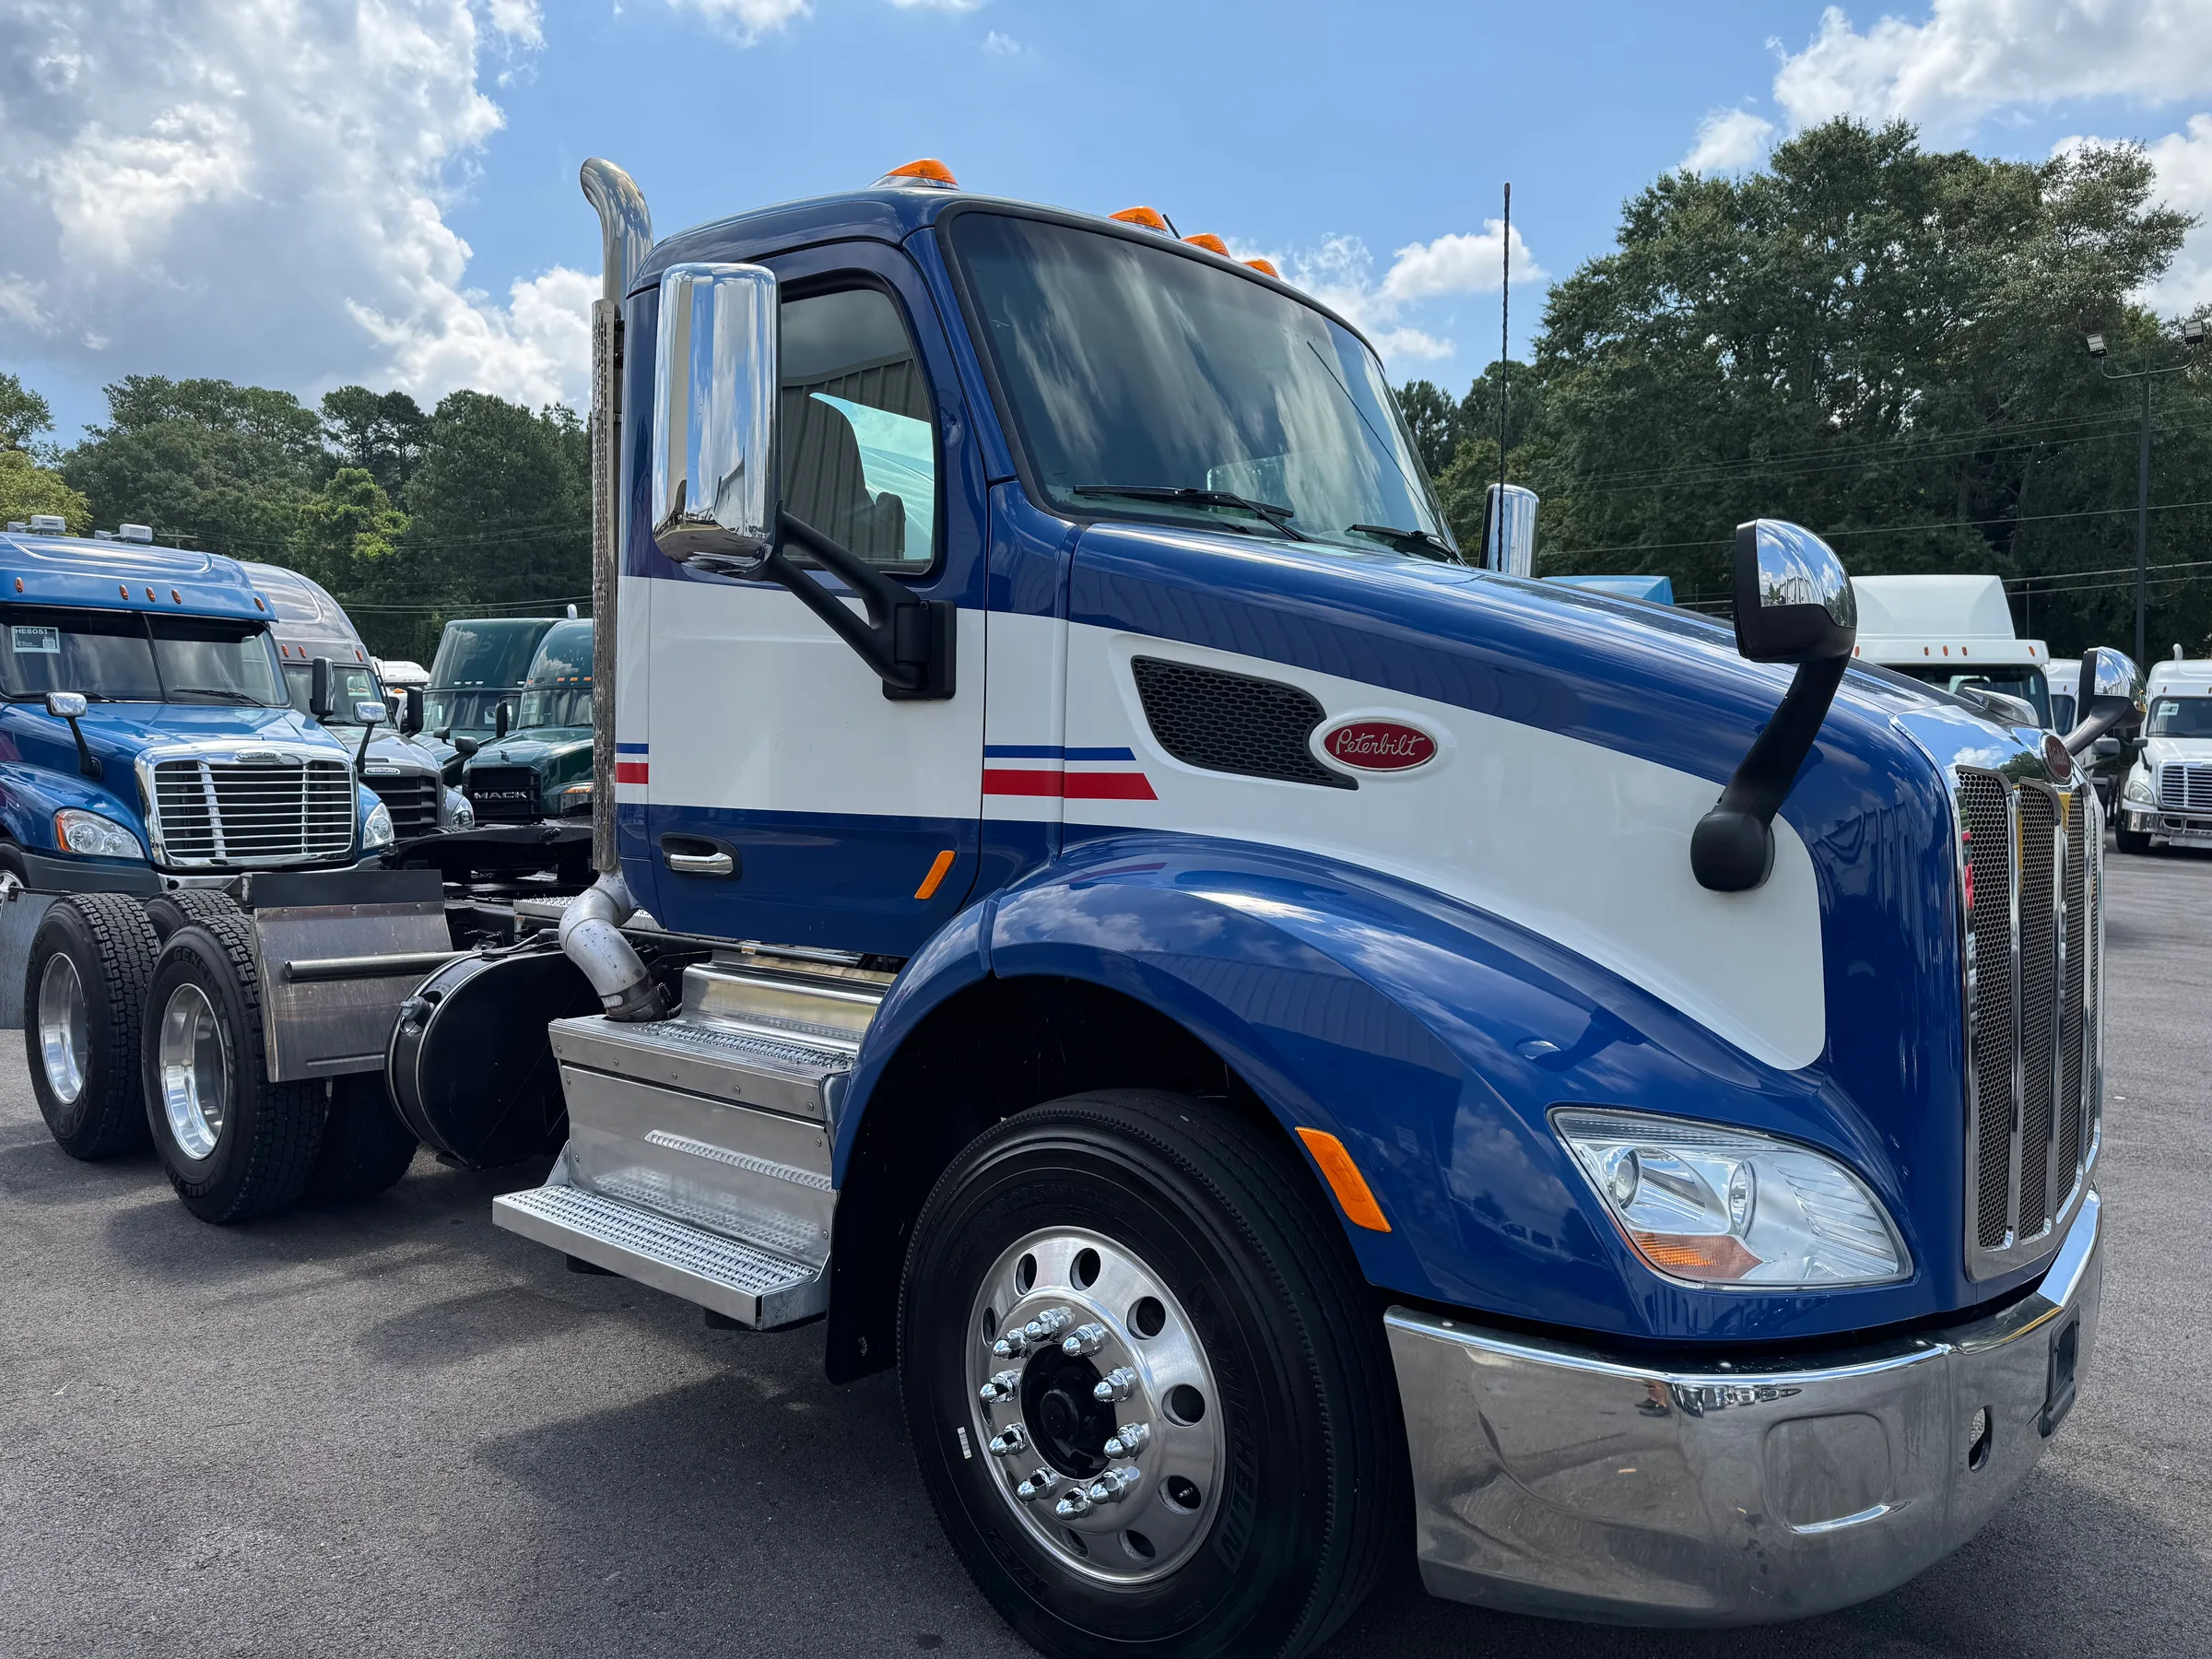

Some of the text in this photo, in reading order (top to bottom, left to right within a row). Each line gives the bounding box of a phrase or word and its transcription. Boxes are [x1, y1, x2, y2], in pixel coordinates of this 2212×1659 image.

[1335, 728, 1426, 757] Peterbilt
[473, 791, 527, 800] MACK
[1214, 1347, 1255, 1567] MICHELIN
